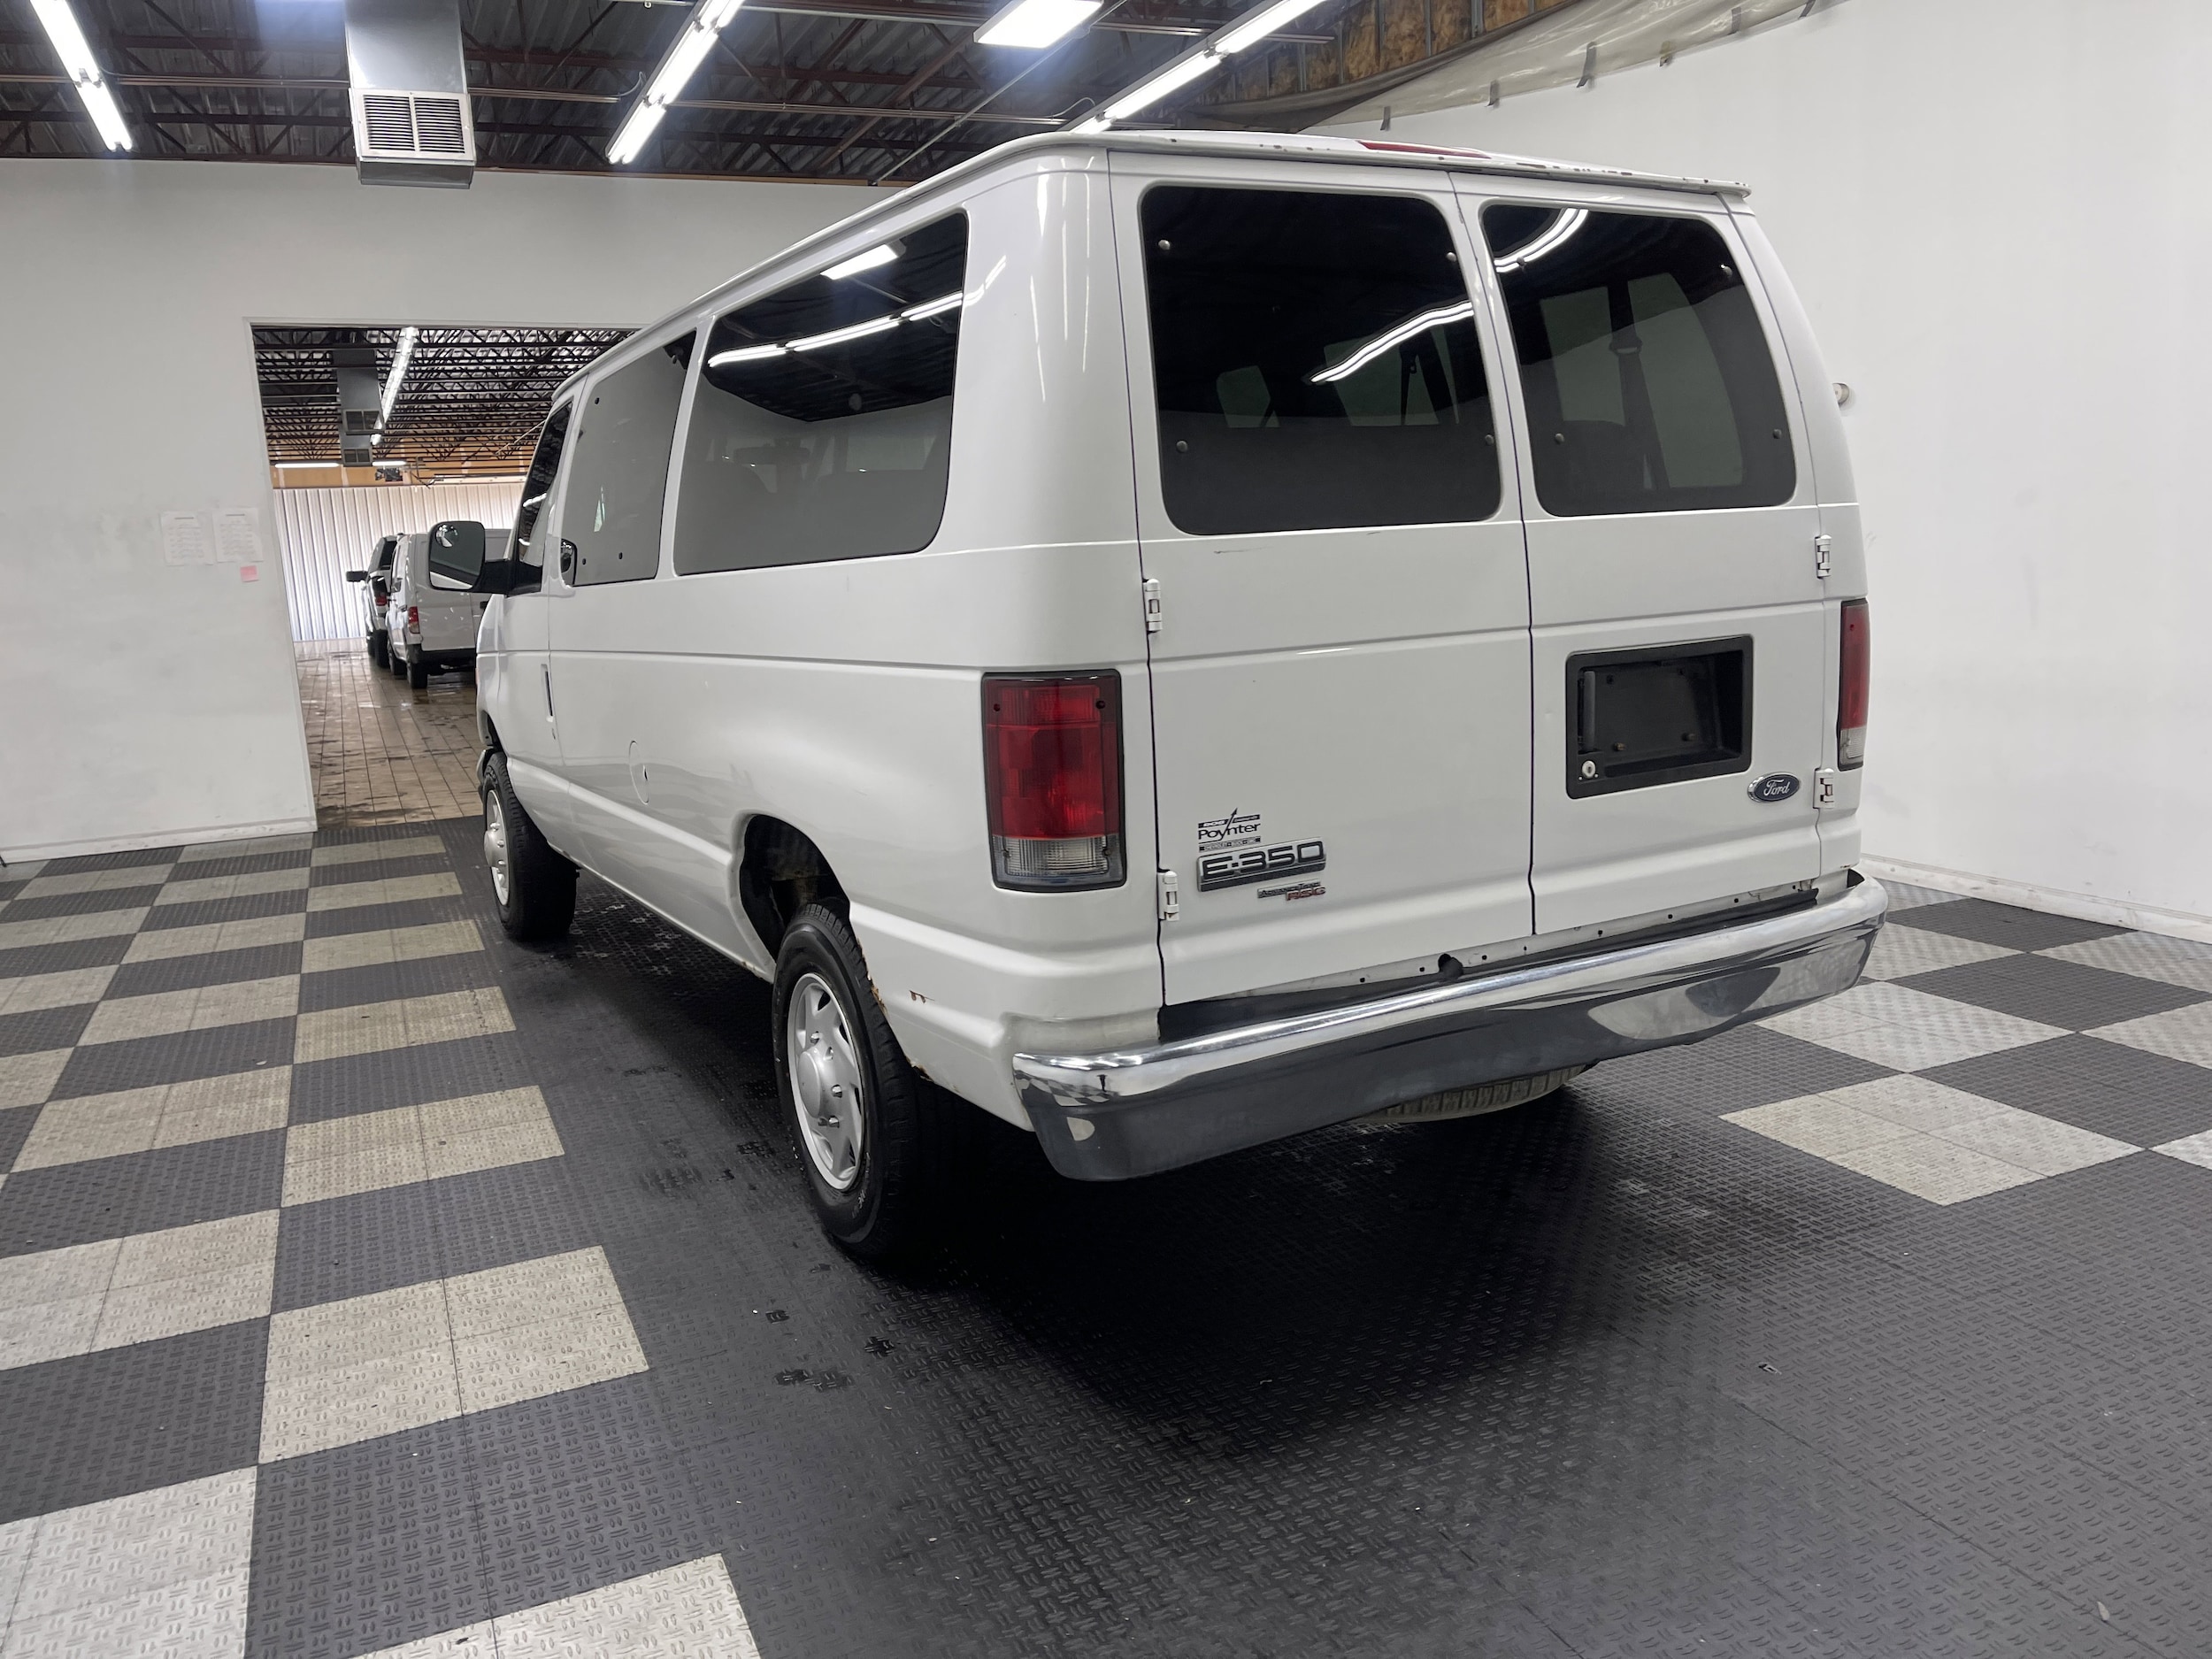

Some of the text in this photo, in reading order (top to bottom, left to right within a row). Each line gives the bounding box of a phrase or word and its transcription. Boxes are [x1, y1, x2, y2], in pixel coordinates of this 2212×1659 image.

[1763, 779, 1791, 796] Ford
[1198, 823, 1261, 841] Poynter
[1286, 887, 1326, 901] RSC
